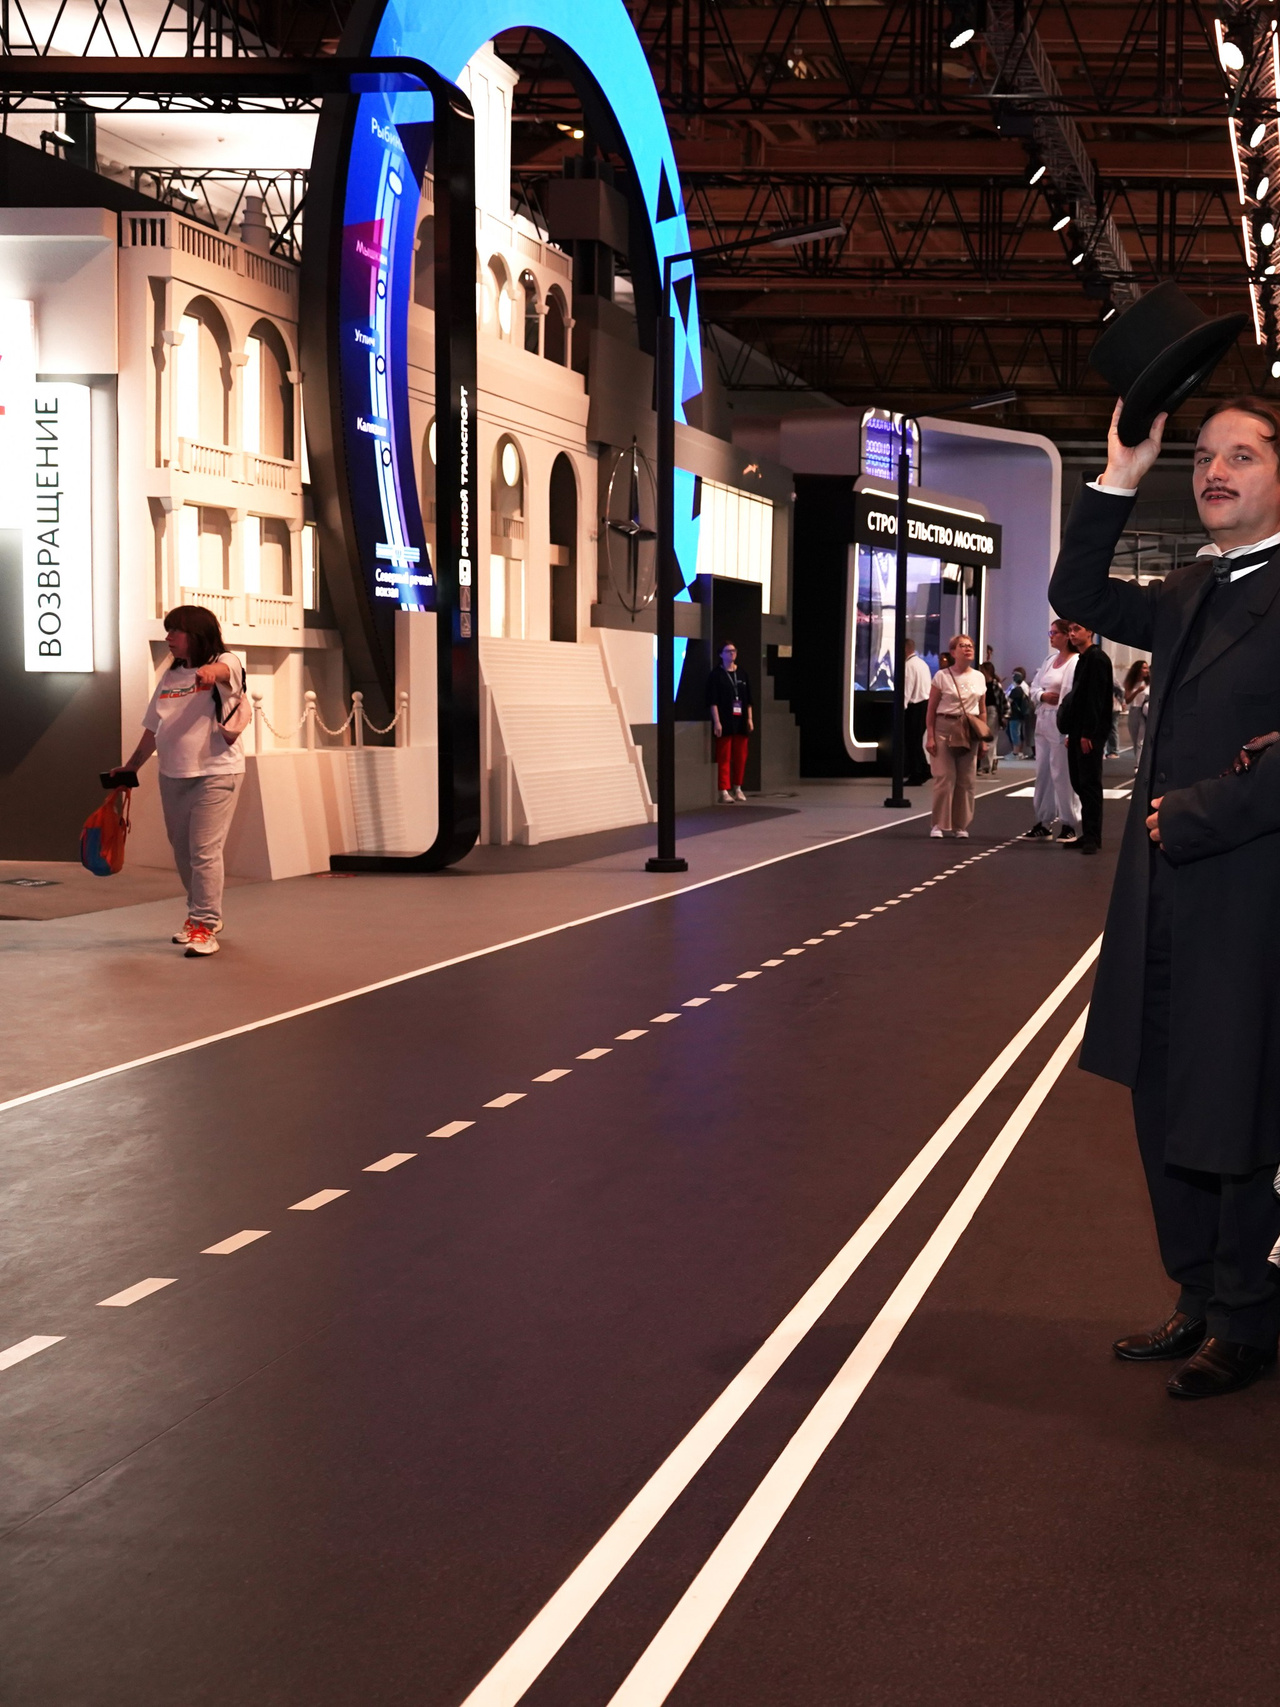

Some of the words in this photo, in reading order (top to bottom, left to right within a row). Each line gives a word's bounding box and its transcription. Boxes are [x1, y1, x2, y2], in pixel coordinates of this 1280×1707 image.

[371, 117, 405, 152] Рыбин
[354, 328, 376, 347] Углич
[460, 385, 469, 485] ТРАНСПОРТ
[35, 397, 63, 657] ВОЗВРАЩЕНИЕ
[460, 489, 470, 557] РЕЧНОЙ
[867, 510, 953, 546] СТРОЕЛЬСТВО
[953, 529, 994, 555] МОСТОВ
